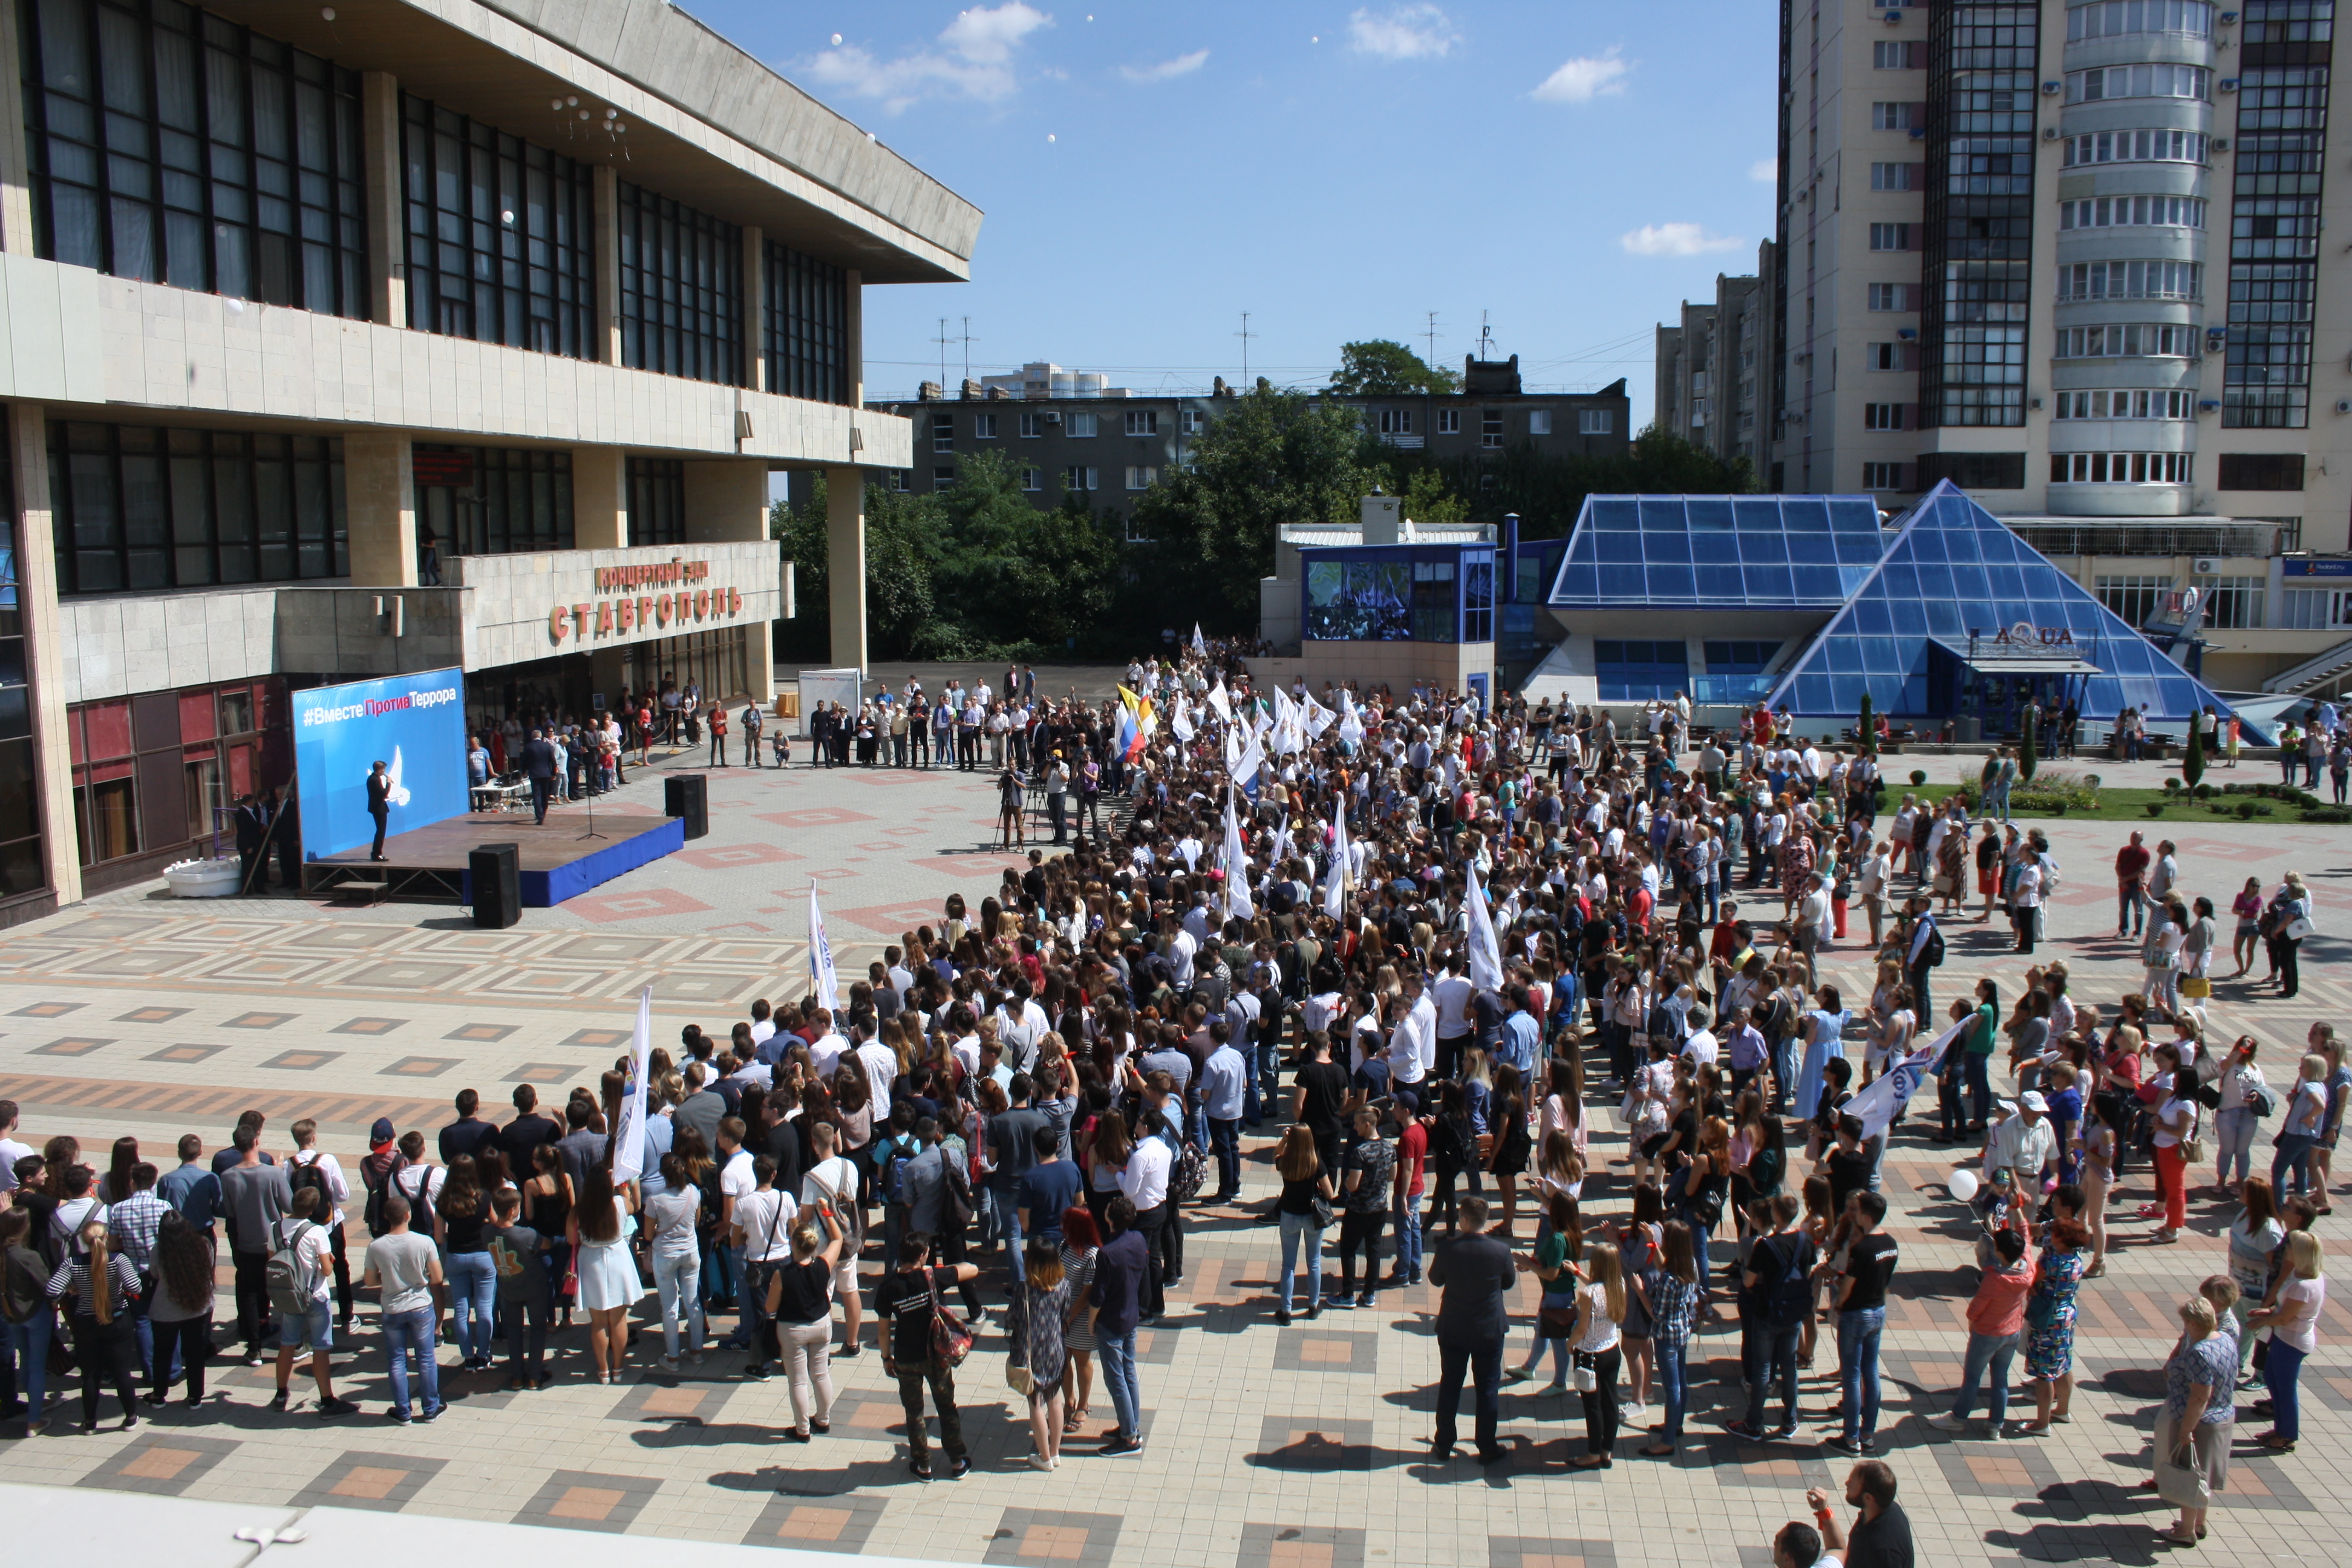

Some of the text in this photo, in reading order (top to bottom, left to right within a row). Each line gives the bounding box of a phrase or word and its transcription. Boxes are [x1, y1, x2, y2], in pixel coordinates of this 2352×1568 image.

[595, 557, 709, 588] КОНЦЕРТНЫЙ ЗАЛ
[549, 586, 742, 639] СТАВРОПОЛЬ
[1993, 621, 2074, 649] AQUA
[1875, 1249, 1898, 1261] ПОЛИЦИЯ
